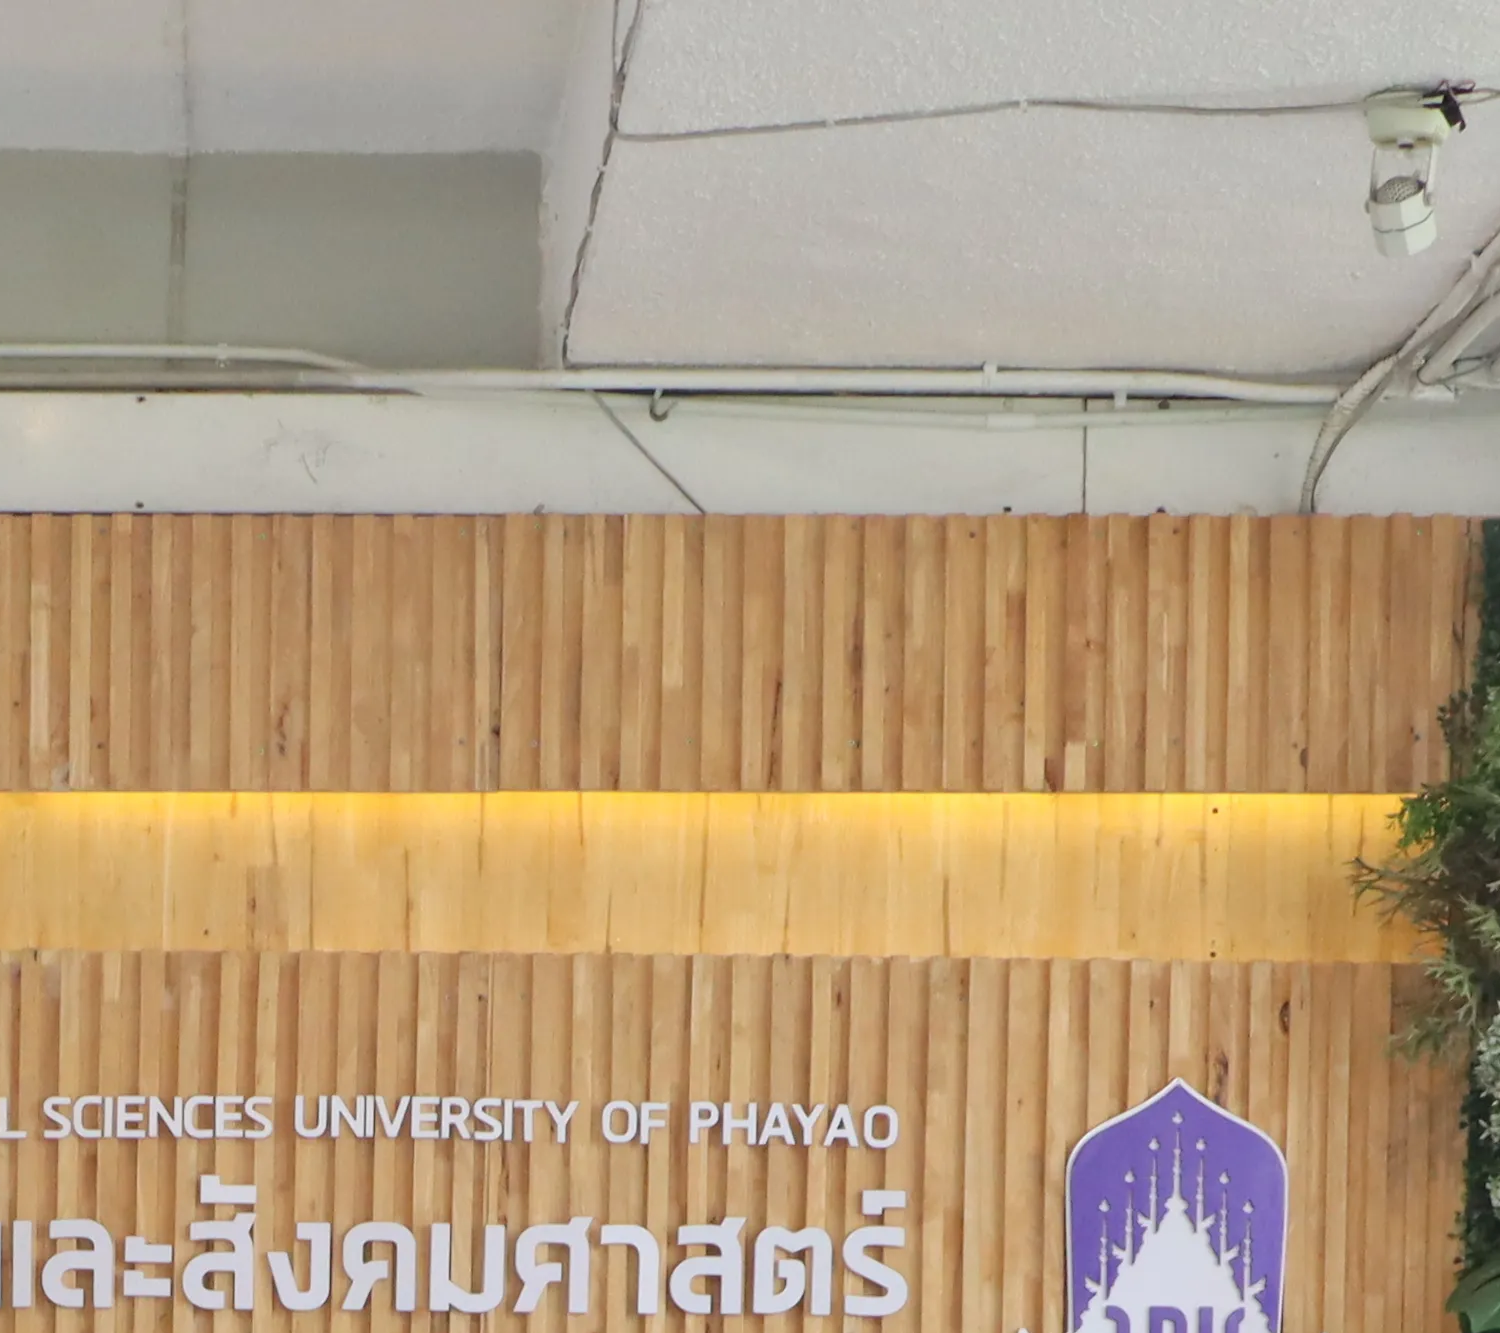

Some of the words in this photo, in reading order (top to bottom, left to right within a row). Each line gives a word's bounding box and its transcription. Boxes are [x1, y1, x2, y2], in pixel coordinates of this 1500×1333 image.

[43, 1094, 274, 1141] SCIENCES
[294, 1094, 580, 1145] UNIVERSITY
[600, 1099, 668, 1147] OF
[688, 1100, 901, 1150] PHAYAO
